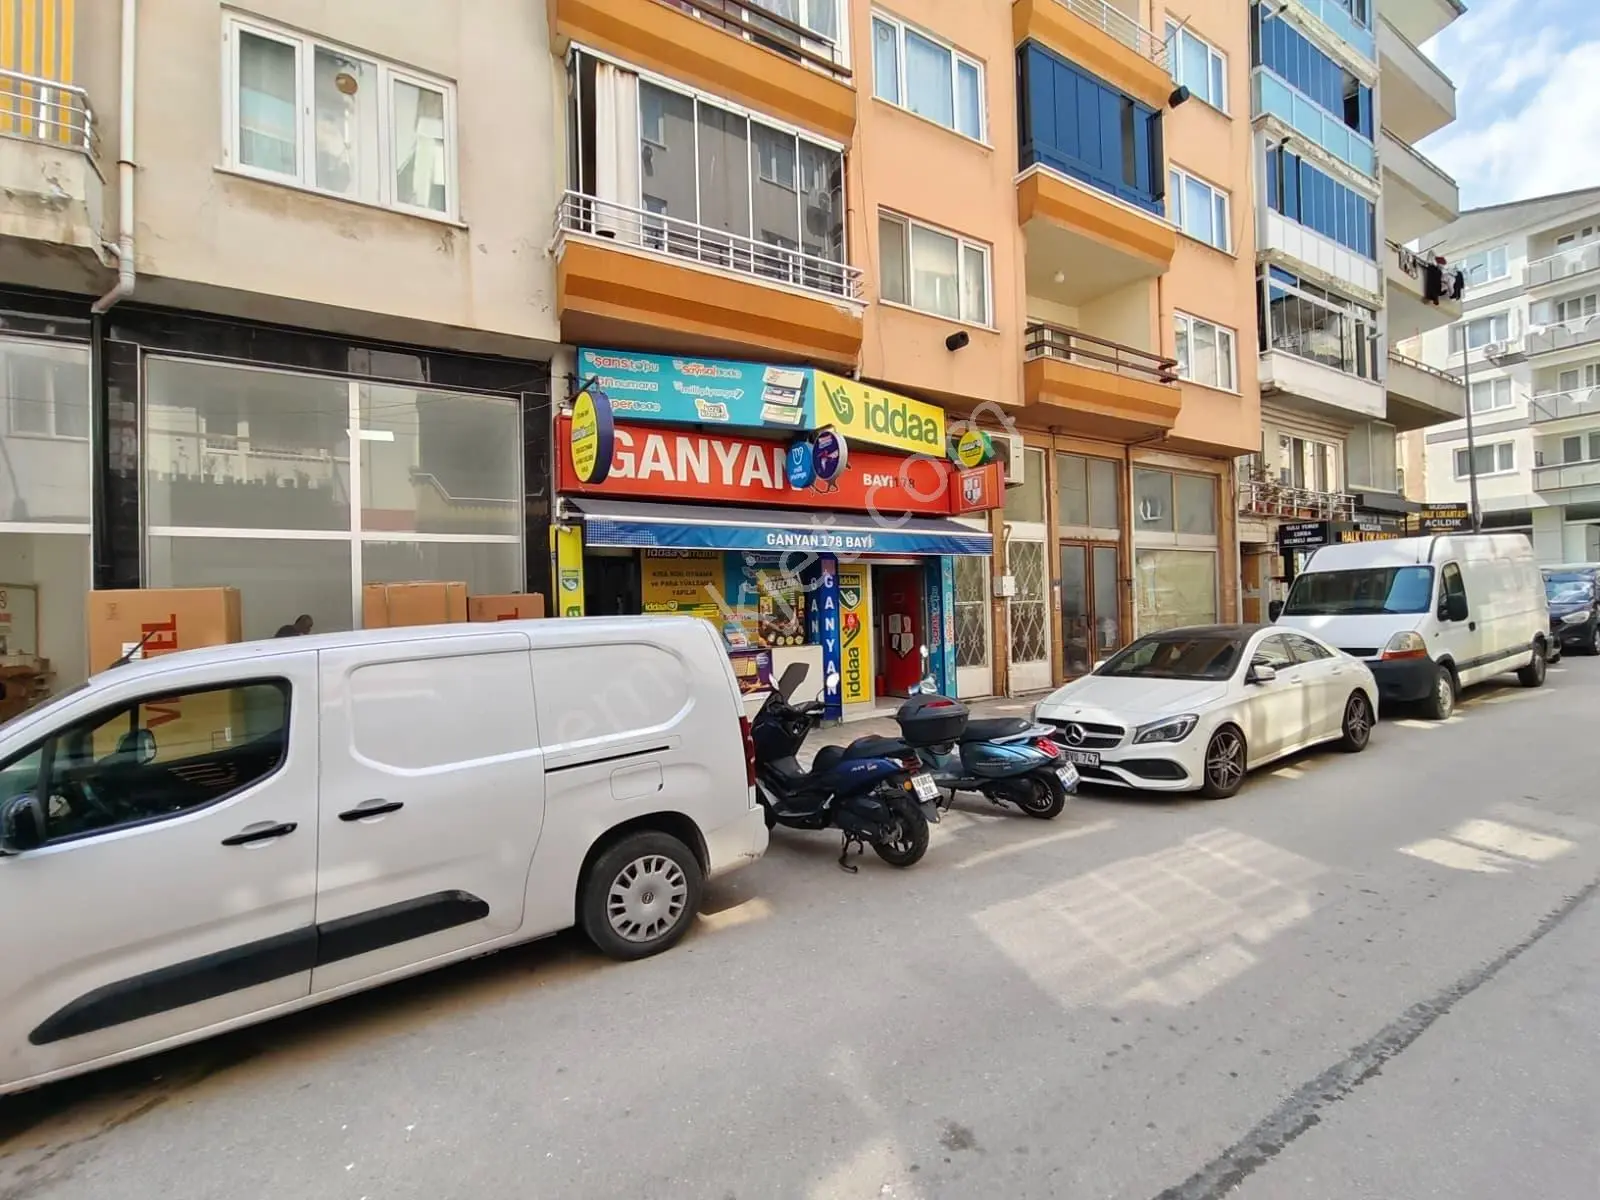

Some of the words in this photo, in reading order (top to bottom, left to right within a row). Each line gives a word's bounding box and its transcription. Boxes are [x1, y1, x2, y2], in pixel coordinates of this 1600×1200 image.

[864, 392, 938, 445] iddaa
[767, 534, 818, 546] GANYAN
[821, 535, 842, 547] 178
[846, 647, 861, 699] iddaa
